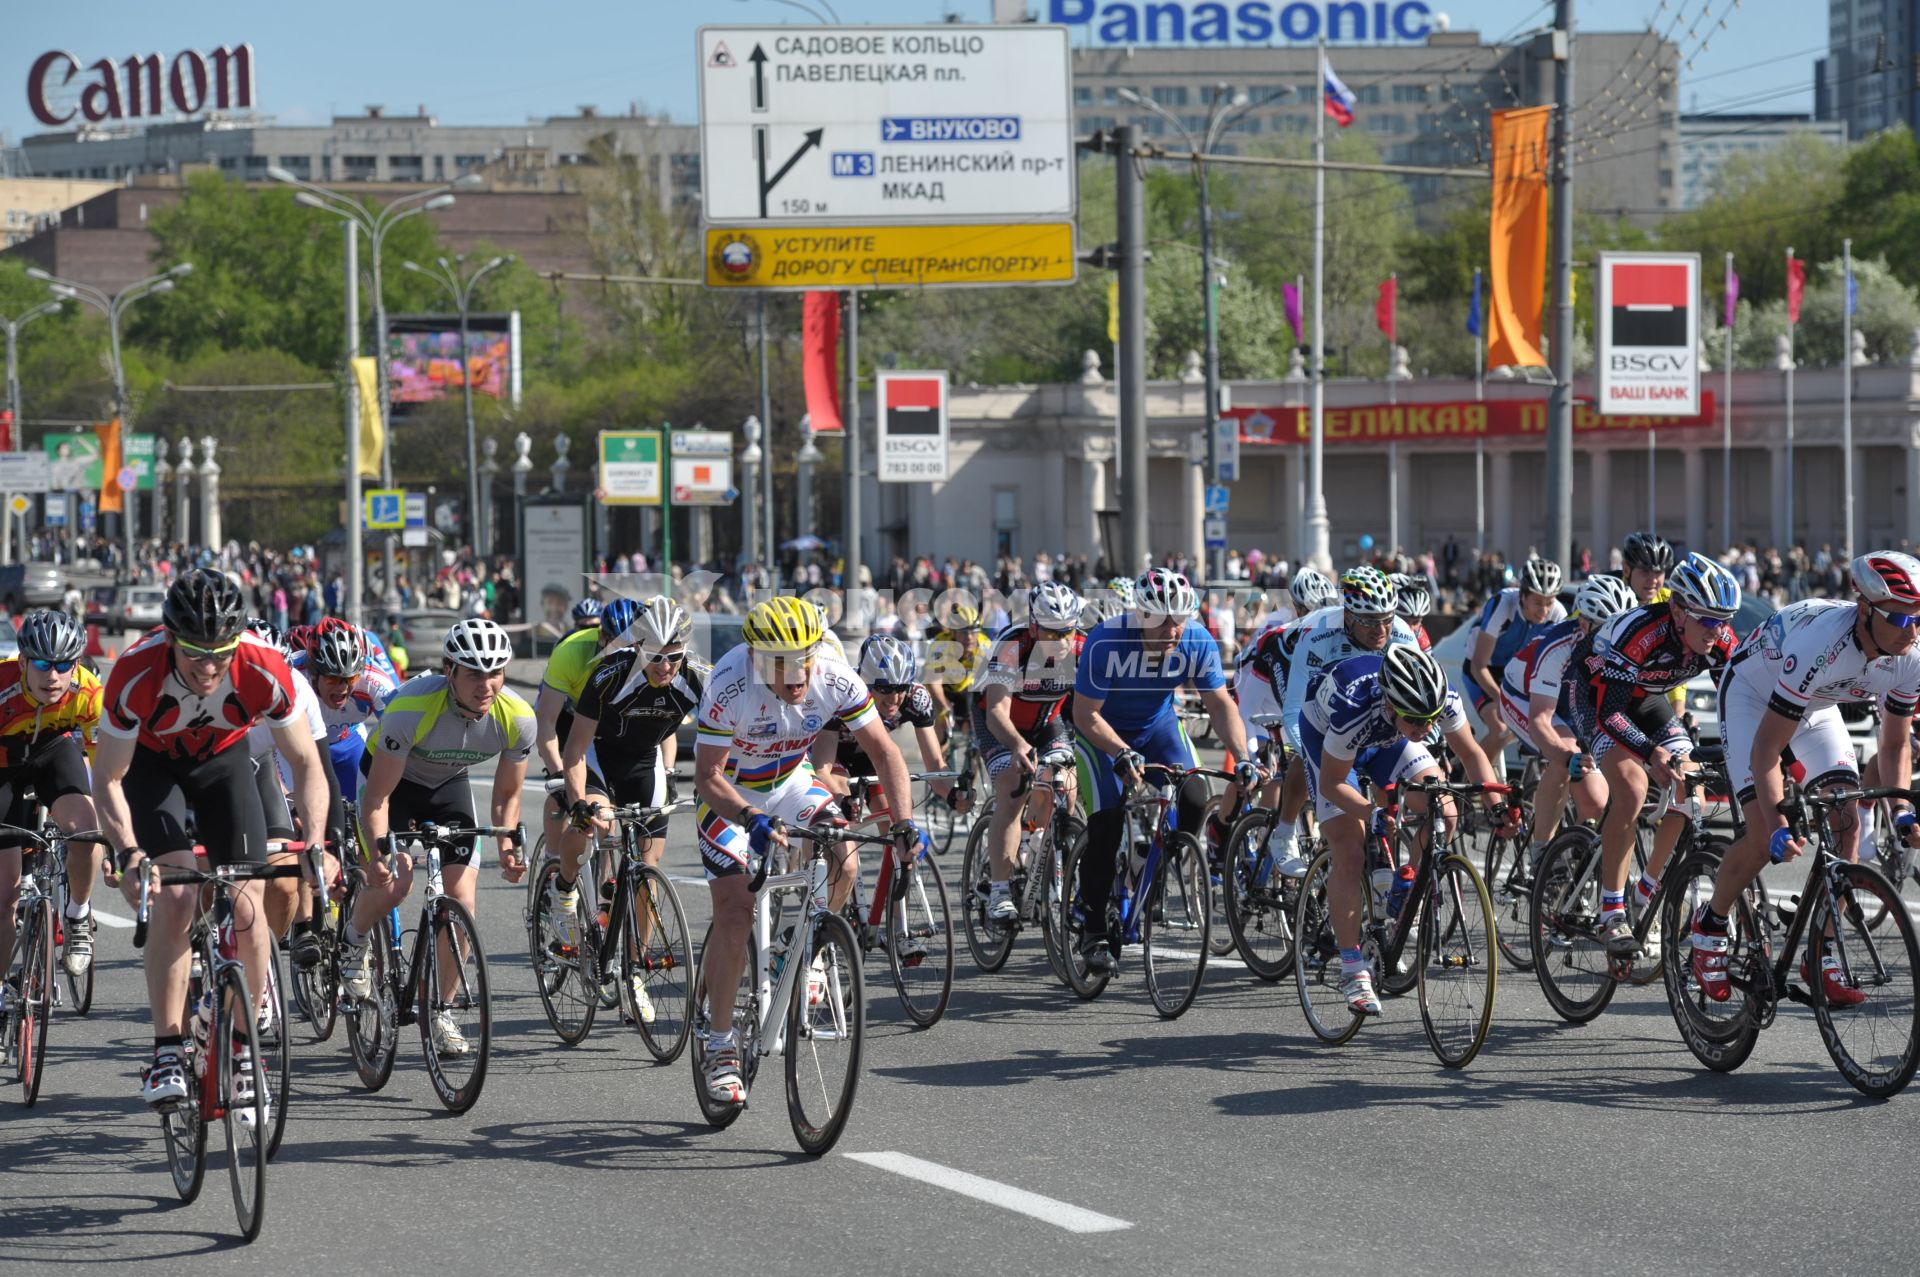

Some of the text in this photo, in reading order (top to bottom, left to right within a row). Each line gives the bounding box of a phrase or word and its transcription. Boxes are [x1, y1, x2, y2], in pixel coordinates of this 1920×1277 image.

[775, 35, 984, 55] САДОВОЕ КОЛЬЦО
[775, 65, 966, 83] ПАВЕЛЕЦКАЯ пл.
[27, 42, 255, 125] Canon
[910, 119, 1017, 139] ВНУКОВО
[880, 151, 1064, 173] ЛЕНИНСКИЙ пр-т
[882, 182, 945, 201] МКАД
[782, 200, 828, 213] 150 м
[773, 236, 876, 253] УСТУПИТЕ
[772, 256, 1048, 278] ДОРОГУ СПЕЦТРАНСПОРТУ!
[1611, 354, 1688, 372] BSGV
[1610, 387, 1688, 400] ВАШ БАНК
[886, 440, 942, 452] BSGV
